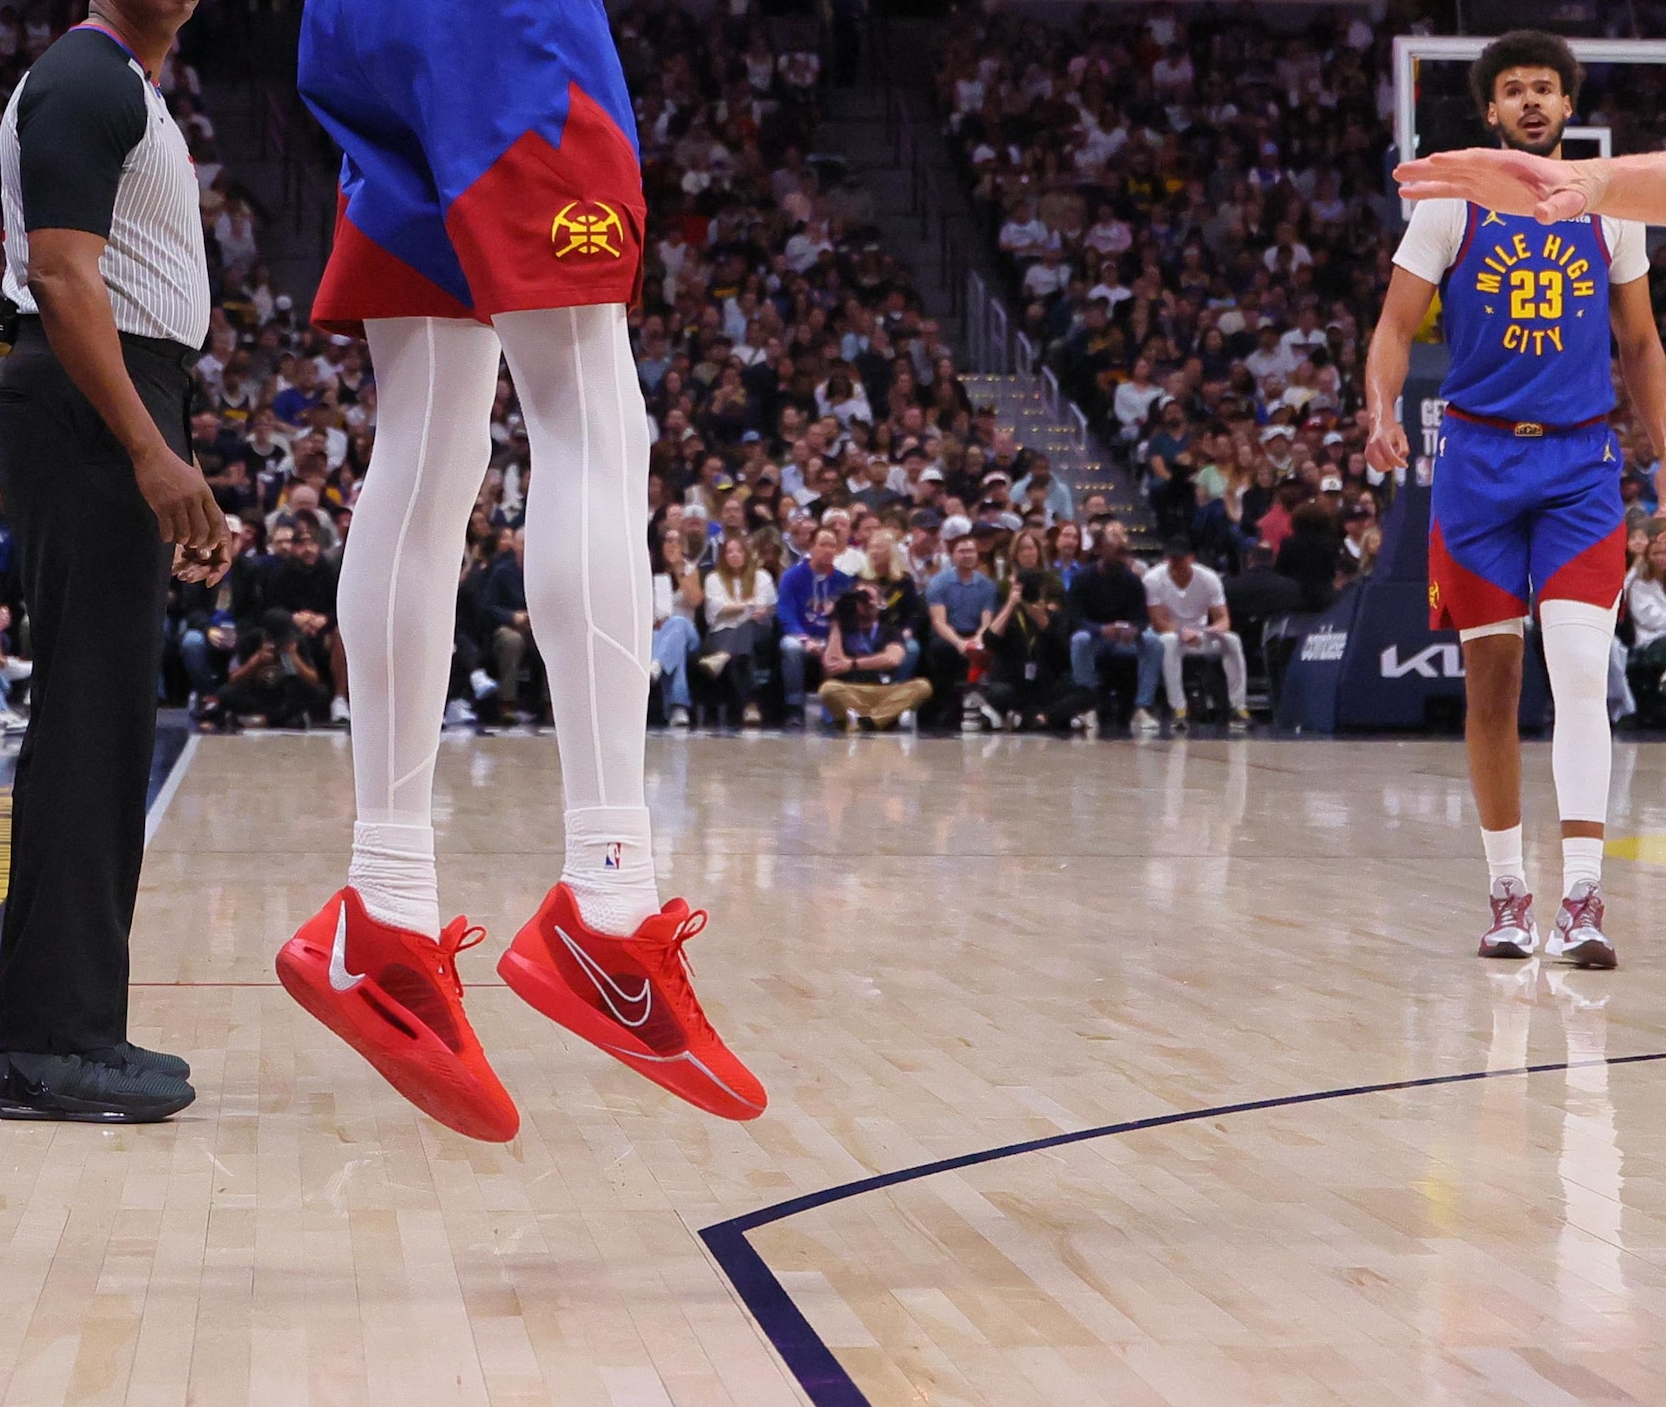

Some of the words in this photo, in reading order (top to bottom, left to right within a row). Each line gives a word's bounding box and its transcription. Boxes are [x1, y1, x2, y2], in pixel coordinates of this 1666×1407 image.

[1475, 232, 1532, 295] MILE
[1542, 233, 1596, 297] HIGH
[1509, 269, 1564, 320] 23
[1502, 323, 1565, 357] CITY
